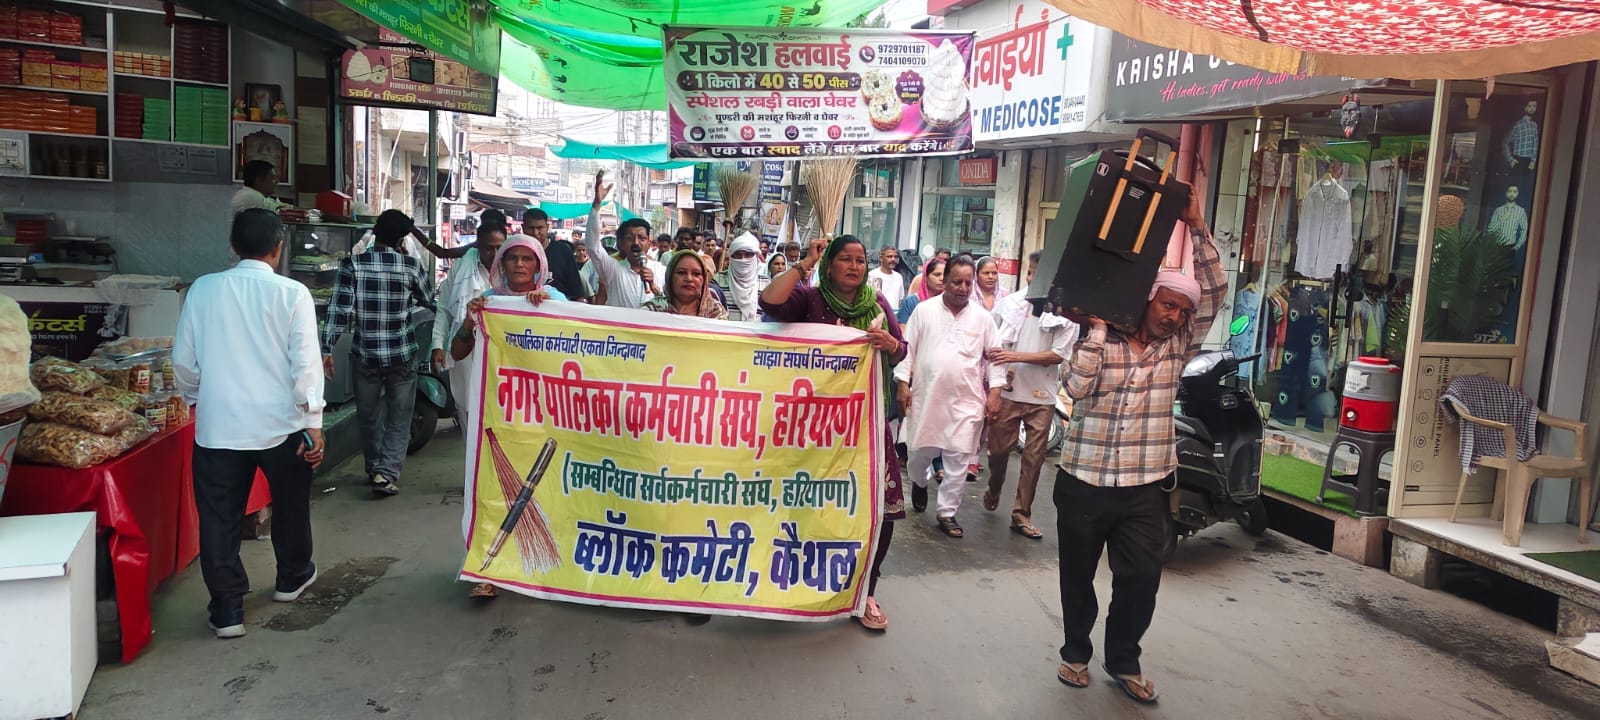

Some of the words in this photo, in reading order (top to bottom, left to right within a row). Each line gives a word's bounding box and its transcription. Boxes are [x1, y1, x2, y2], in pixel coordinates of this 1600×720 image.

[677, 33, 769, 68] राजेश
[773, 34, 852, 71] हलवाई
[877, 44, 926, 55] 9729701187
[878, 56, 927, 66] 7404109070
[1116, 50, 1195, 87] KRISHA
[694, 74, 702, 89] 1
[707, 73, 741, 89] किलो
[744, 74, 756, 89] में
[760, 74, 785, 90] 40
[787, 76, 800, 89] से
[803, 74, 826, 90] 50
[829, 77, 849, 89] पीस
[686, 92, 741, 109] स्पेशल
[744, 92, 784, 112] रबड़ी
[786, 96, 821, 109] वाला
[822, 93, 858, 108] घेवर
[981, 95, 1062, 133] MEDICOSE
[742, 112, 755, 121] की
[757, 114, 784, 124] मशहूर
[786, 112, 811, 121] फिरनी
[821, 112, 839, 121] घेवर
[711, 145, 737, 156] एक
[741, 145, 765, 155] बार
[767, 144, 800, 156] स्वाद
[833, 142, 856, 153] बार
[859, 142, 880, 152] बार
[882, 141, 907, 152] याद
[961, 162, 989, 179] ONIDA
[545, 331, 580, 354] कर्मचारी
[581, 339, 605, 358] एकता
[606, 335, 647, 362] जिन्दाबाद
[753, 346, 782, 370] सांझा
[783, 347, 811, 369] संघर्ष
[811, 348, 859, 373] जिन्दाबाद
[625, 366, 719, 446] कर्मचारी
[720, 371, 767, 460] संघ,
[772, 379, 866, 448] हरियाणा
[1433, 433, 1442, 457] PANEL
[562, 452, 638, 499] (सम्बन्धित
[640, 467, 739, 504] सर्वकर्मचारी
[741, 471, 777, 513] संघ,
[782, 471, 857, 516] हरियाणा)
[574, 510, 656, 578] ब्लॉक
[660, 519, 759, 596] कमेटी,
[770, 521, 862, 593] कैथल
